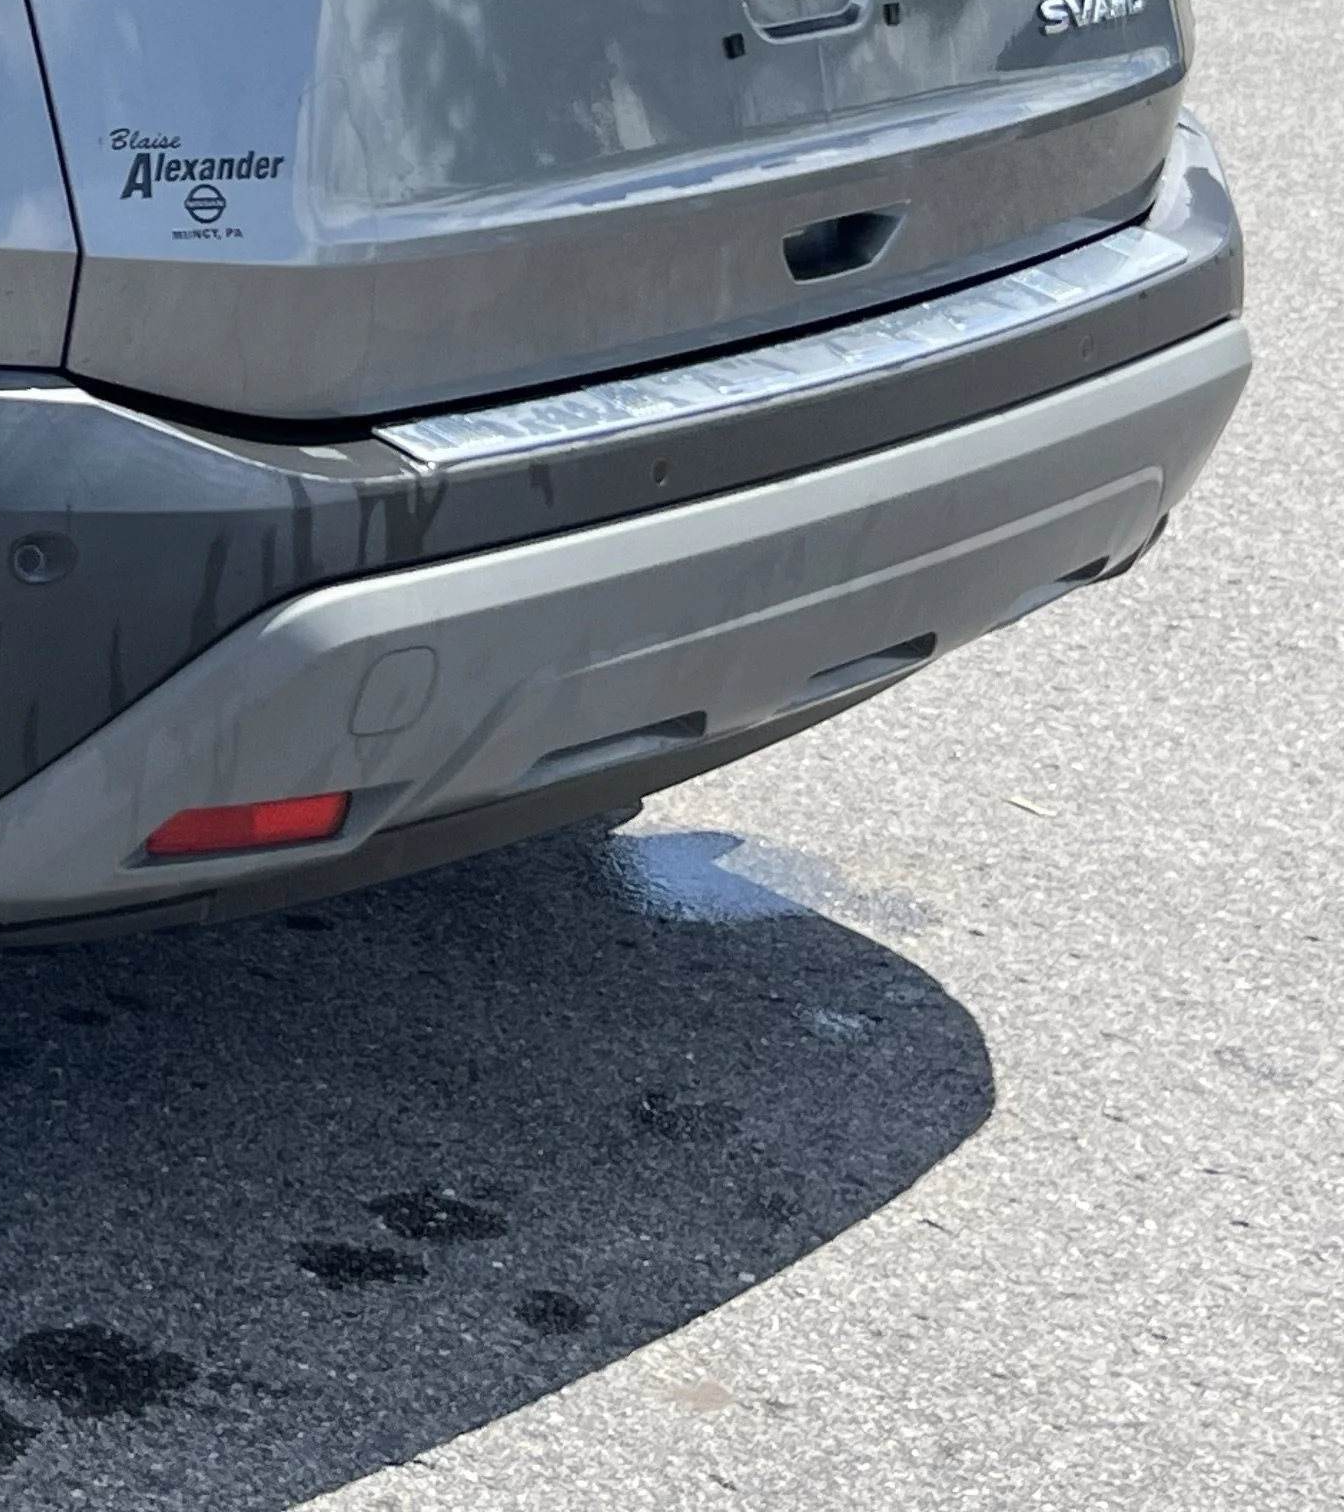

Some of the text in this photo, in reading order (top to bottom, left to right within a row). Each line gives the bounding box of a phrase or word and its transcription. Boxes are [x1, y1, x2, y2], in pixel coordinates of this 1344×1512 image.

[109, 128, 181, 150] Blaise
[120, 151, 285, 199] Alexander
[225, 227, 243, 239] PA
